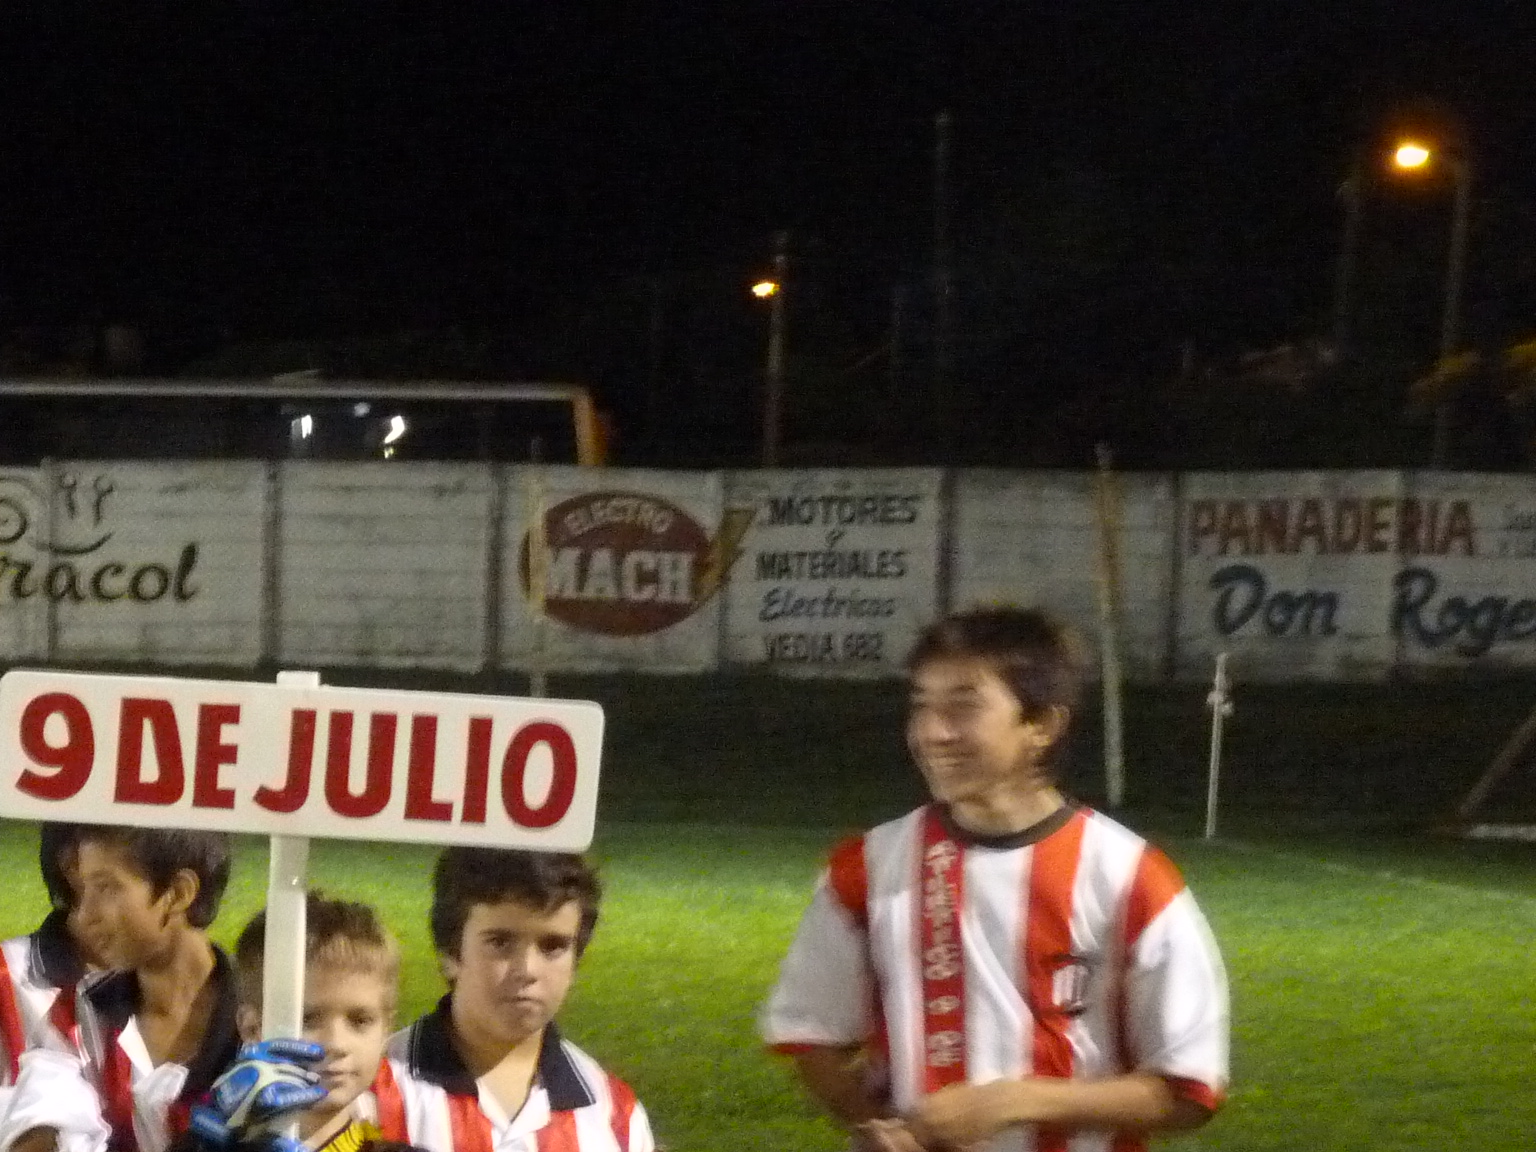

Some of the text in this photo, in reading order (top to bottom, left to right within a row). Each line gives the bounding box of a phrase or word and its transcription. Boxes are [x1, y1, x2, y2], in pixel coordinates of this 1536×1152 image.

[767, 494, 921, 526] MOTORES
[1190, 498, 1475, 556] PANADERIA
[547, 547, 696, 603] MACH
[755, 549, 909, 580] MATERIALES
[1210, 563, 1340, 635] Don
[15, 691, 578, 829] 9 DE JULIO
